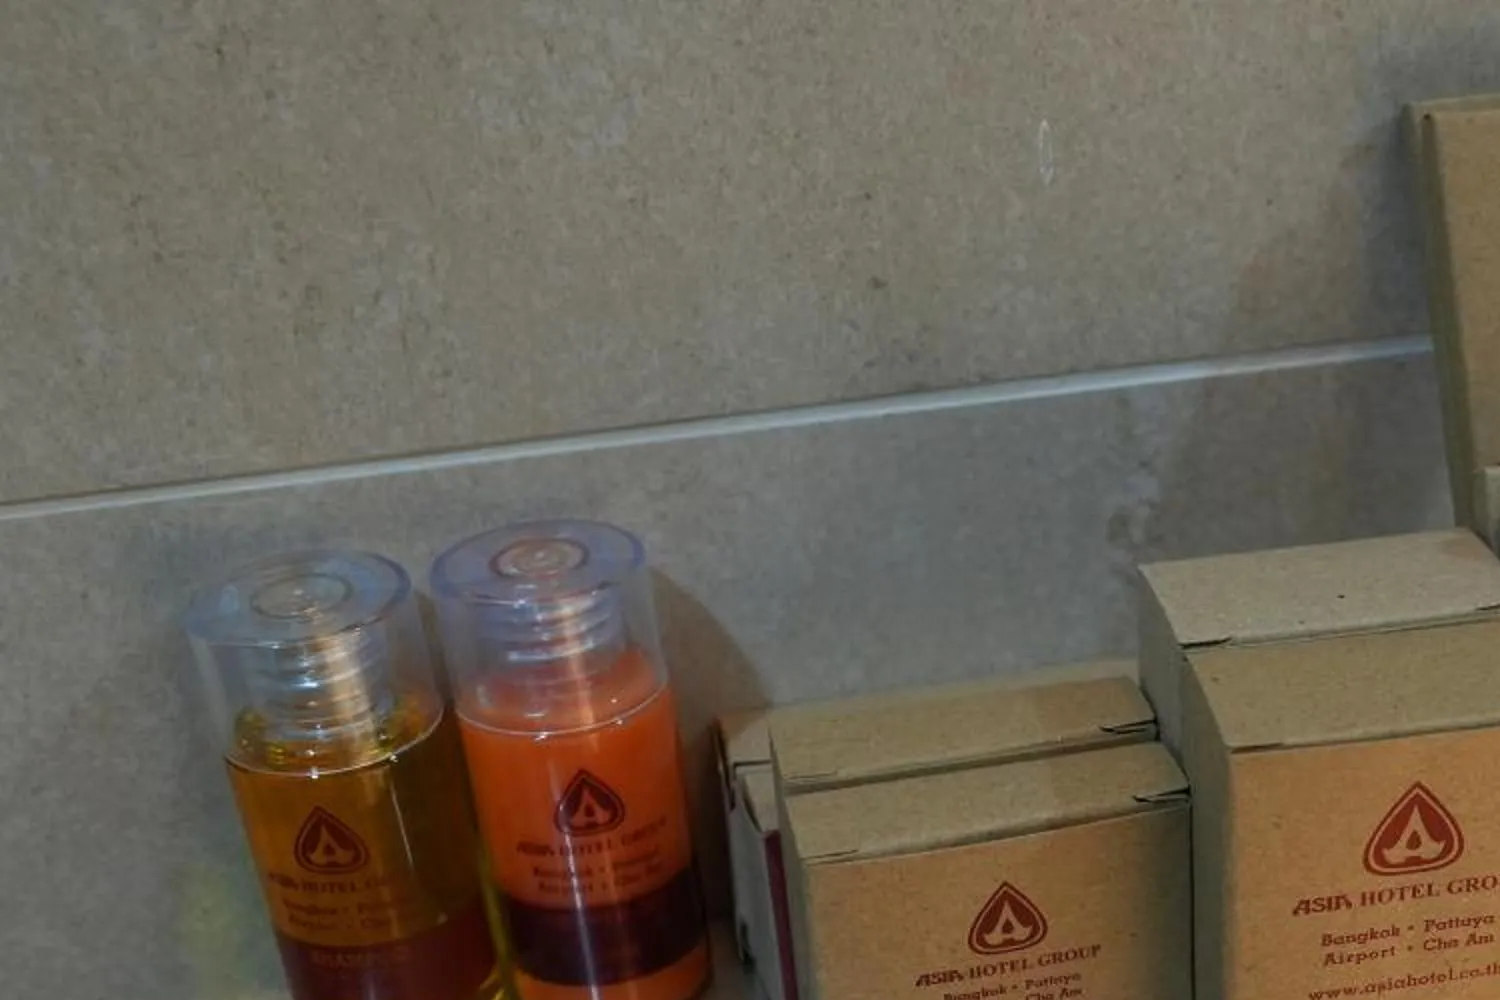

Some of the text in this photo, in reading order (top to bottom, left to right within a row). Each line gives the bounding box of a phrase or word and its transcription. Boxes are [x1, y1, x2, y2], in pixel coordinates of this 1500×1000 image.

[1292, 890, 1352, 917] ASIA
[1360, 881, 1441, 909] HOTEL
[1321, 911, 1496, 949] Bangkok Pattaya
[915, 944, 1102, 987] ASIA HOTEL GROUP
[1322, 931, 1495, 969] Airport Cha Am
